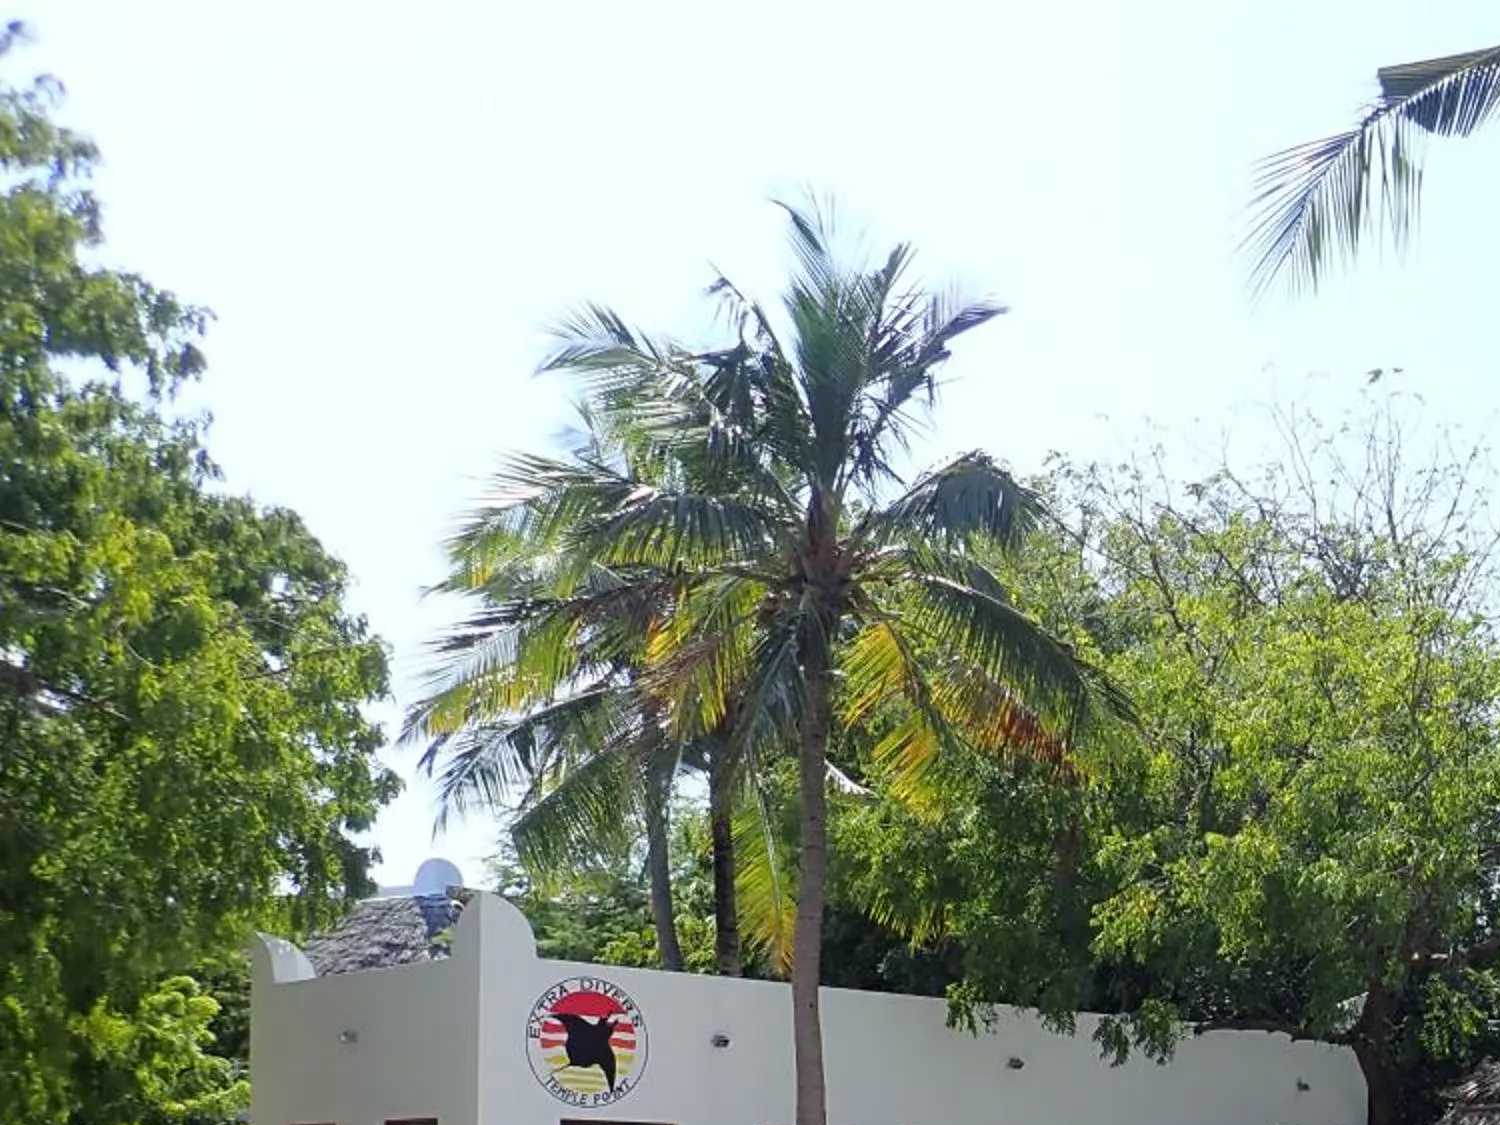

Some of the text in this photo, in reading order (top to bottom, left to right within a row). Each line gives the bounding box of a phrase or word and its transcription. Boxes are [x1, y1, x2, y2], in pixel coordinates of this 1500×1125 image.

[529, 979, 643, 1039] EXTRA DIVERS
[543, 1072, 589, 1105] TEMPLE
